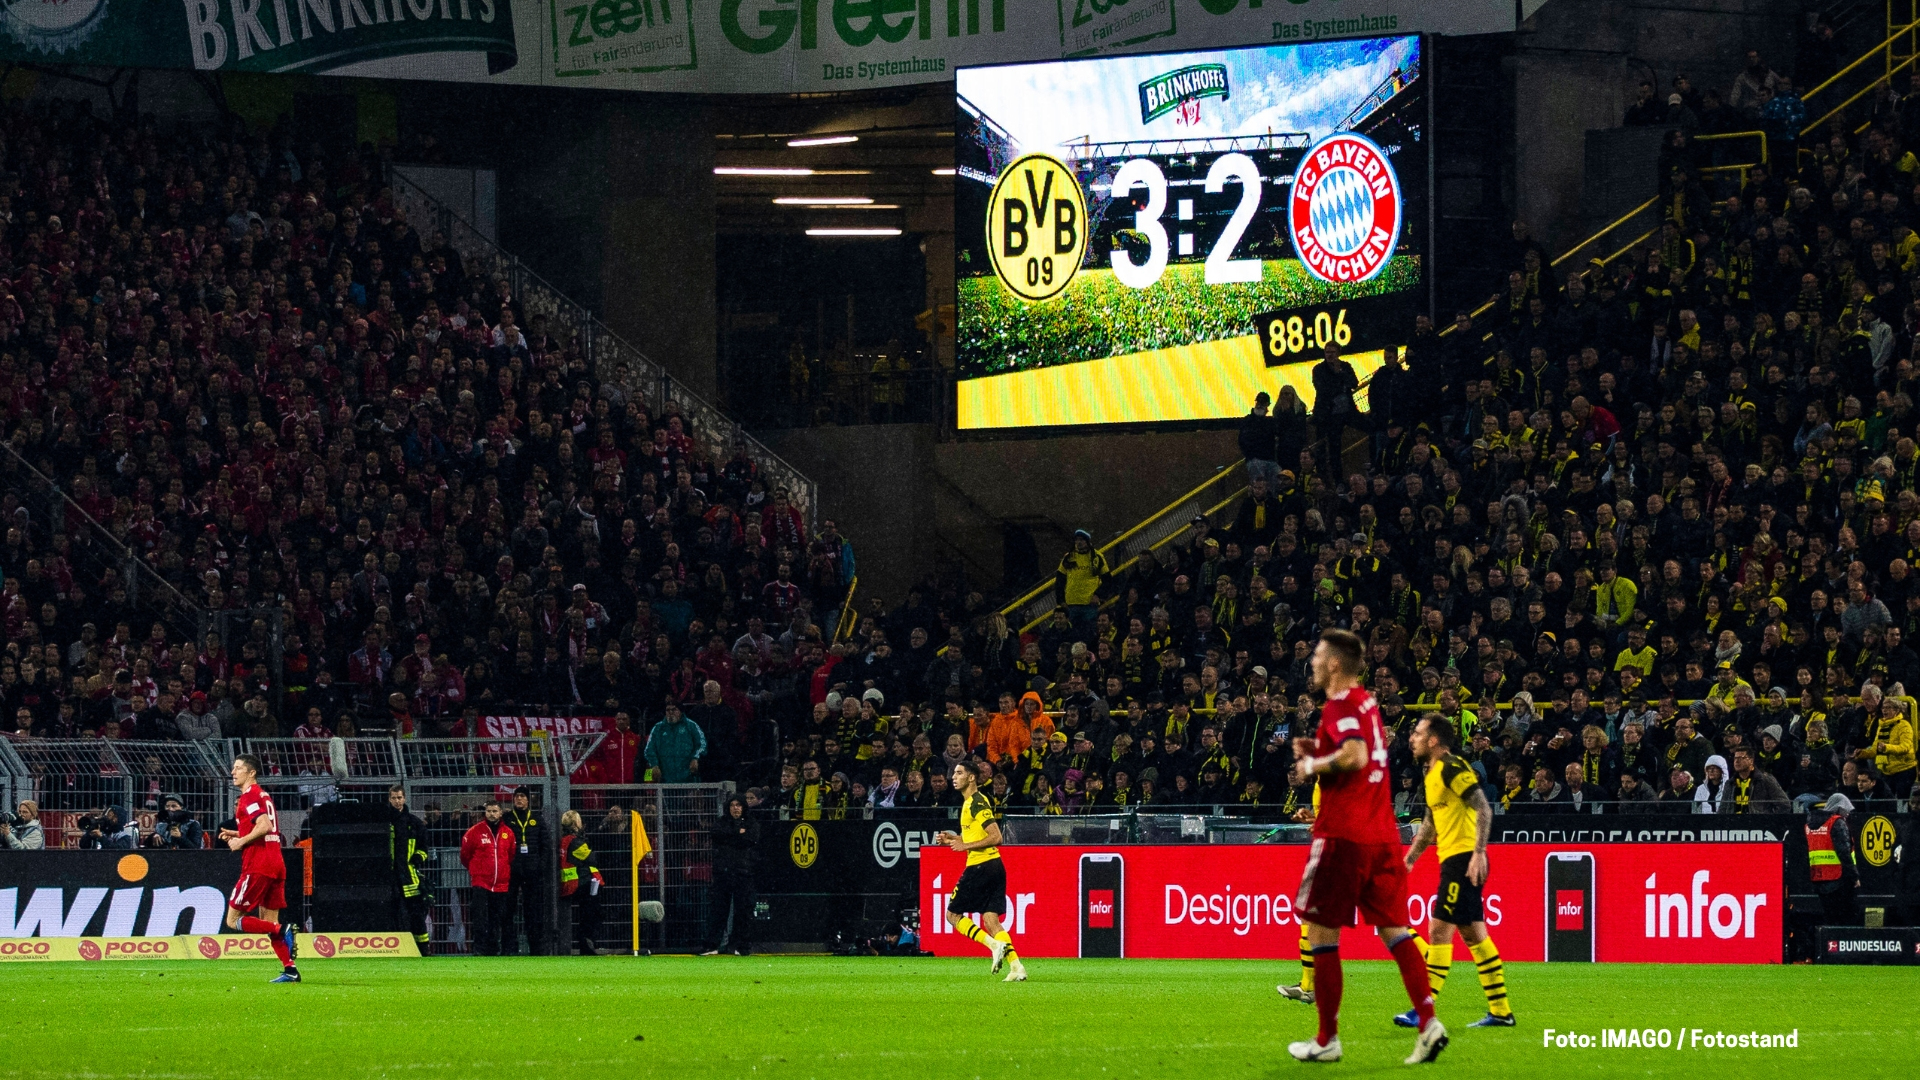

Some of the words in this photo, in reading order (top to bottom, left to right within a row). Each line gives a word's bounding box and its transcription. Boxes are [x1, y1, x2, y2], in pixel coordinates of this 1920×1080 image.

[1271, 22, 1299, 39] Das
[1303, 14, 1398, 38] Systemhaus
[822, 63, 854, 80] Das
[857, 56, 946, 80] Systemhaus
[1297, 167, 1316, 201] FC
[1316, 143, 1390, 200] BAYERN
[1003, 169, 1077, 257] BVB
[1298, 225, 1390, 281] MÜNCHEN
[1027, 257, 1054, 287] 09
[1269, 309, 1352, 357] 88:06
[1371, 714, 1388, 768] 4
[265, 800, 278, 833] 9
[794, 828, 815, 854] BVB
[1866, 821, 1892, 851] BVB
[800, 853, 808, 863] 09
[1873, 850, 1884, 861] 09
[1447, 882, 1460, 903] 9
[1645, 869, 1767, 939] infor
[1090, 900, 1112, 914] infor
[1558, 902, 1581, 916] infor
[105, 942, 169, 956] POCO
[224, 938, 271, 952] POC
[338, 936, 400, 951] POCO
[1838, 940, 1902, 952] BUNDESLIGA
